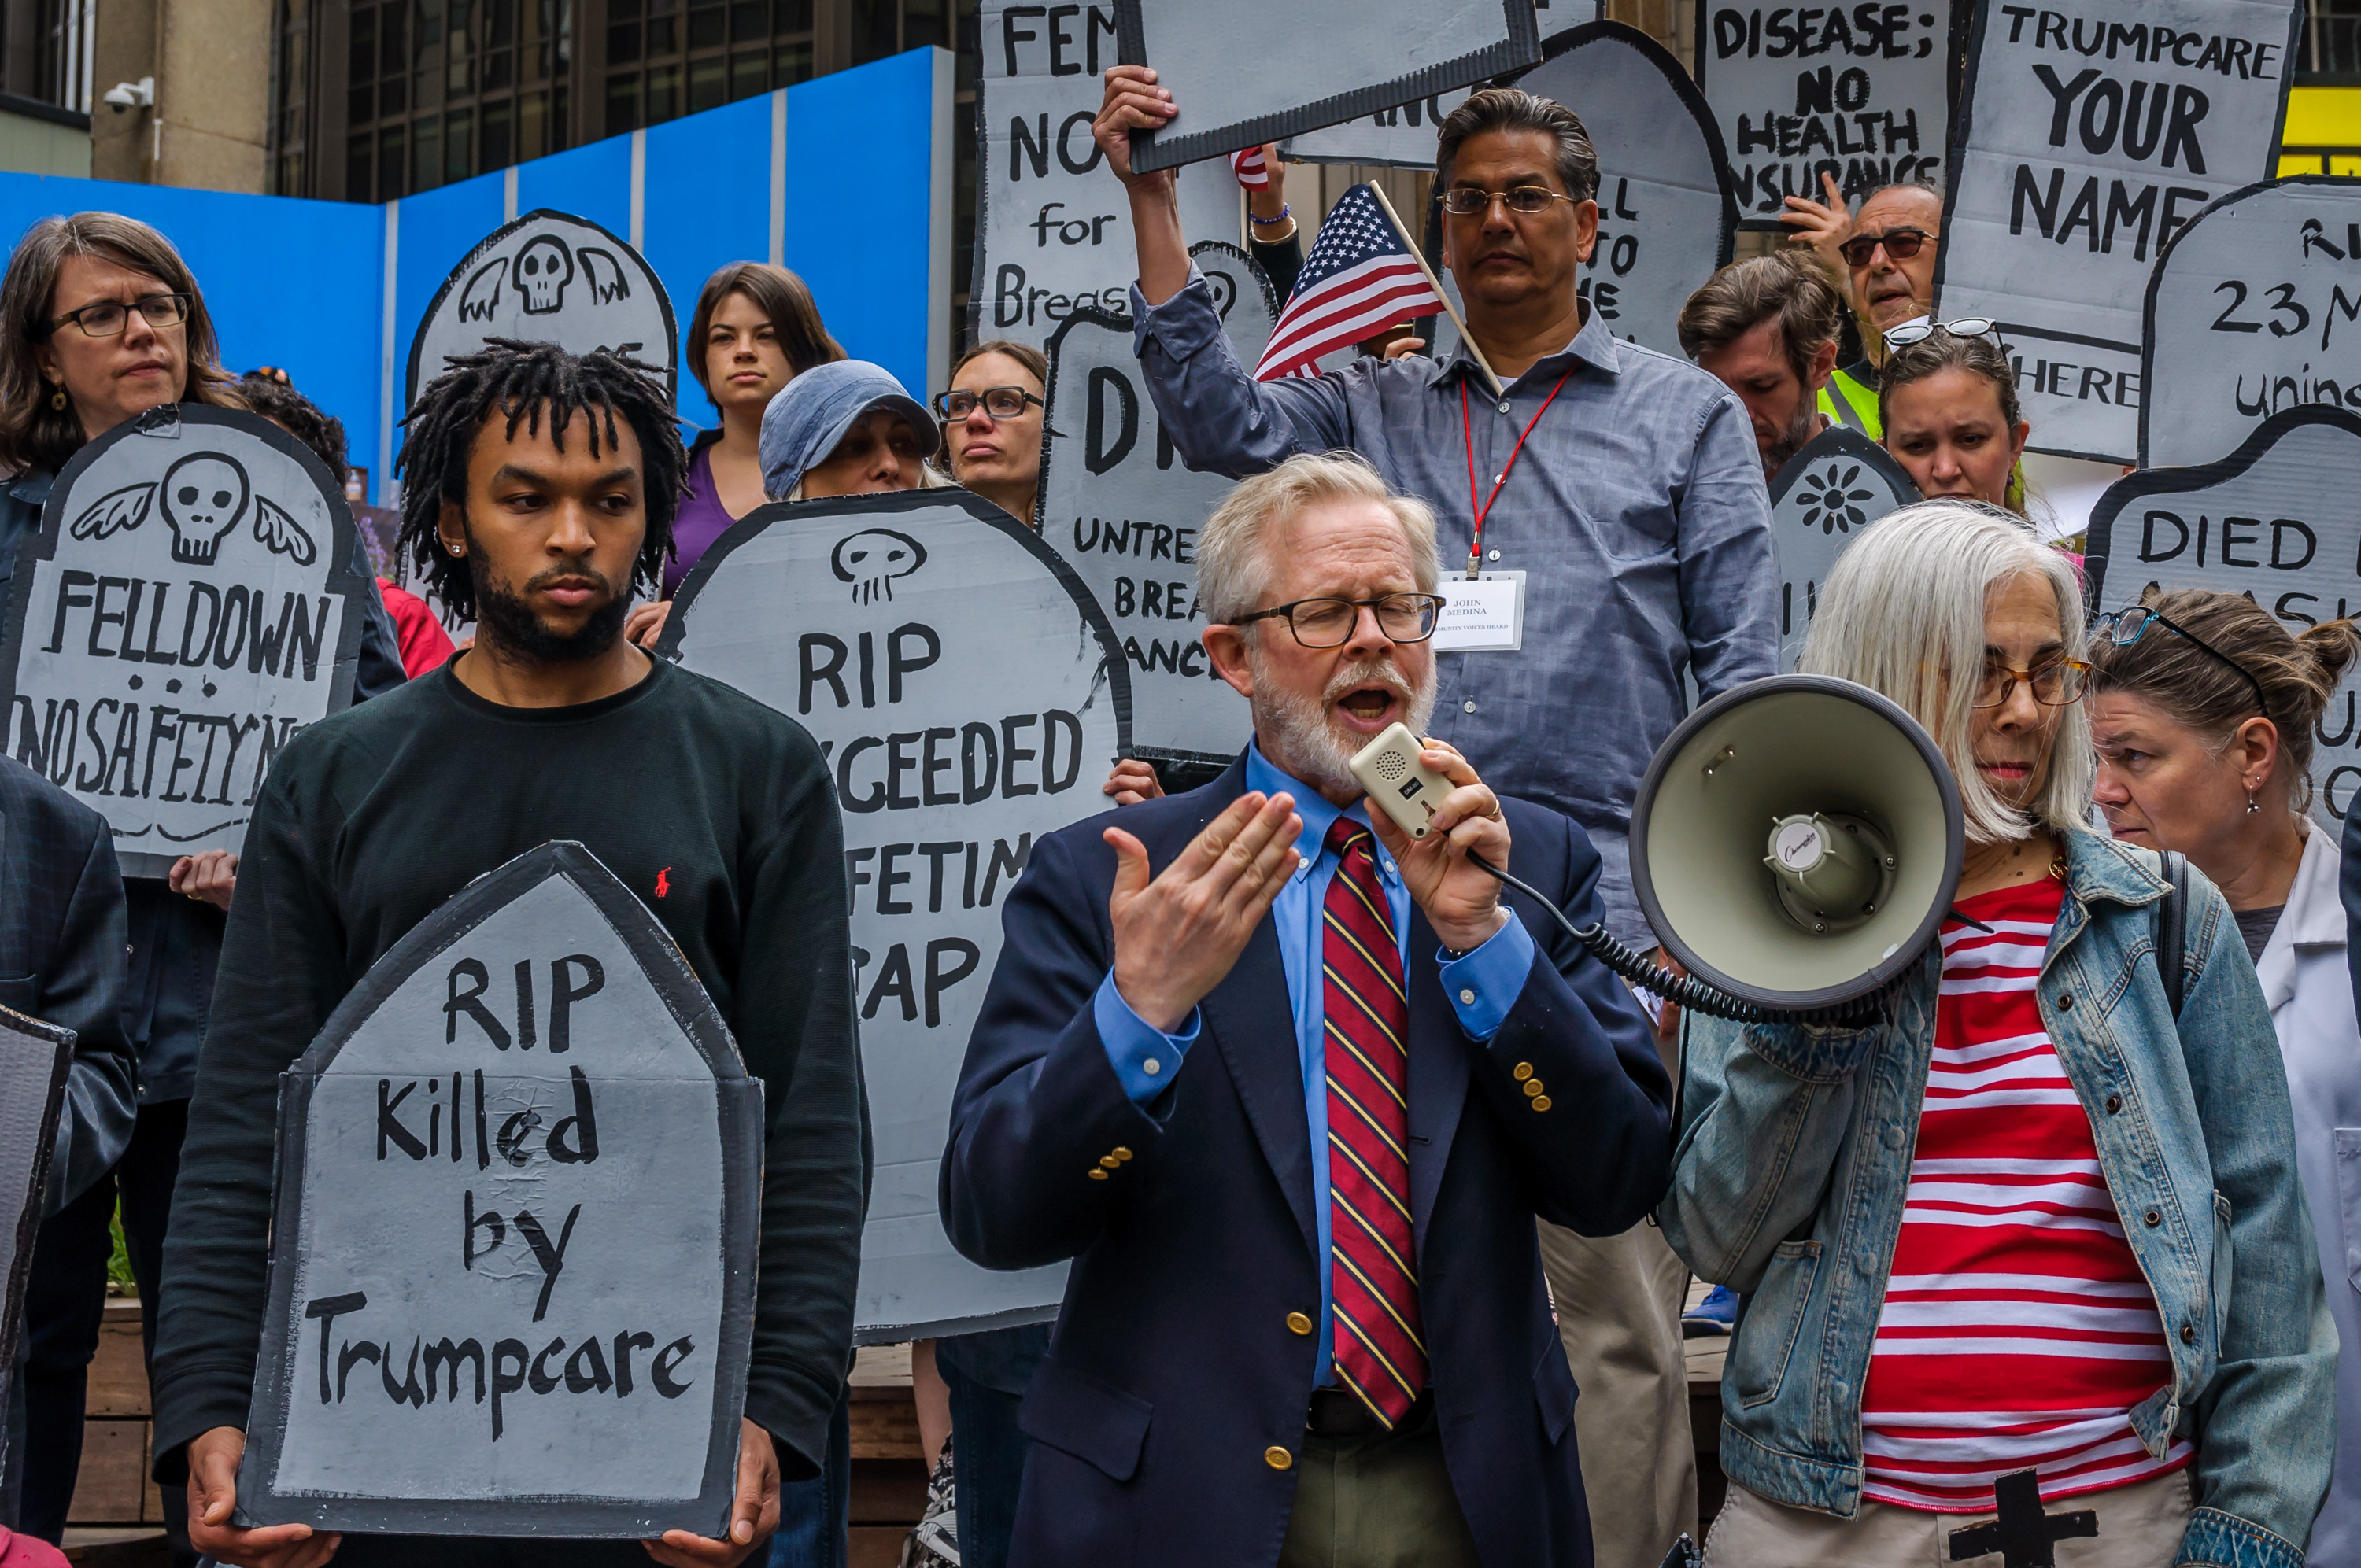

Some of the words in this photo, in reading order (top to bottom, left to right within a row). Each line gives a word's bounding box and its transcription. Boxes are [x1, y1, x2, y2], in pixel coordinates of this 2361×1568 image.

[1713, 3, 1935, 59] DISEASE;
[2001, 4, 2282, 80] TRUMPCARE
[1794, 65, 1871, 117] NO
[2031, 64, 2210, 175] YOUR
[1737, 107, 1919, 157] HEALTH
[1029, 202, 1116, 247] for
[2210, 279, 2311, 338] 23
[2012, 356, 2141, 409] HERE
[2137, 510, 2318, 570] DIED
[1447, 607, 1487, 617] MEDINA
[1453, 599, 1482, 607] JOHN
[798, 622, 942, 715] RIP
[819, 708, 1084, 814] CEEDED
[443, 954, 606, 1054] RIP
[376, 1064, 600, 1171] Killed
[462, 1189, 582, 1324] by
[305, 1291, 697, 1443] Trumpcare
